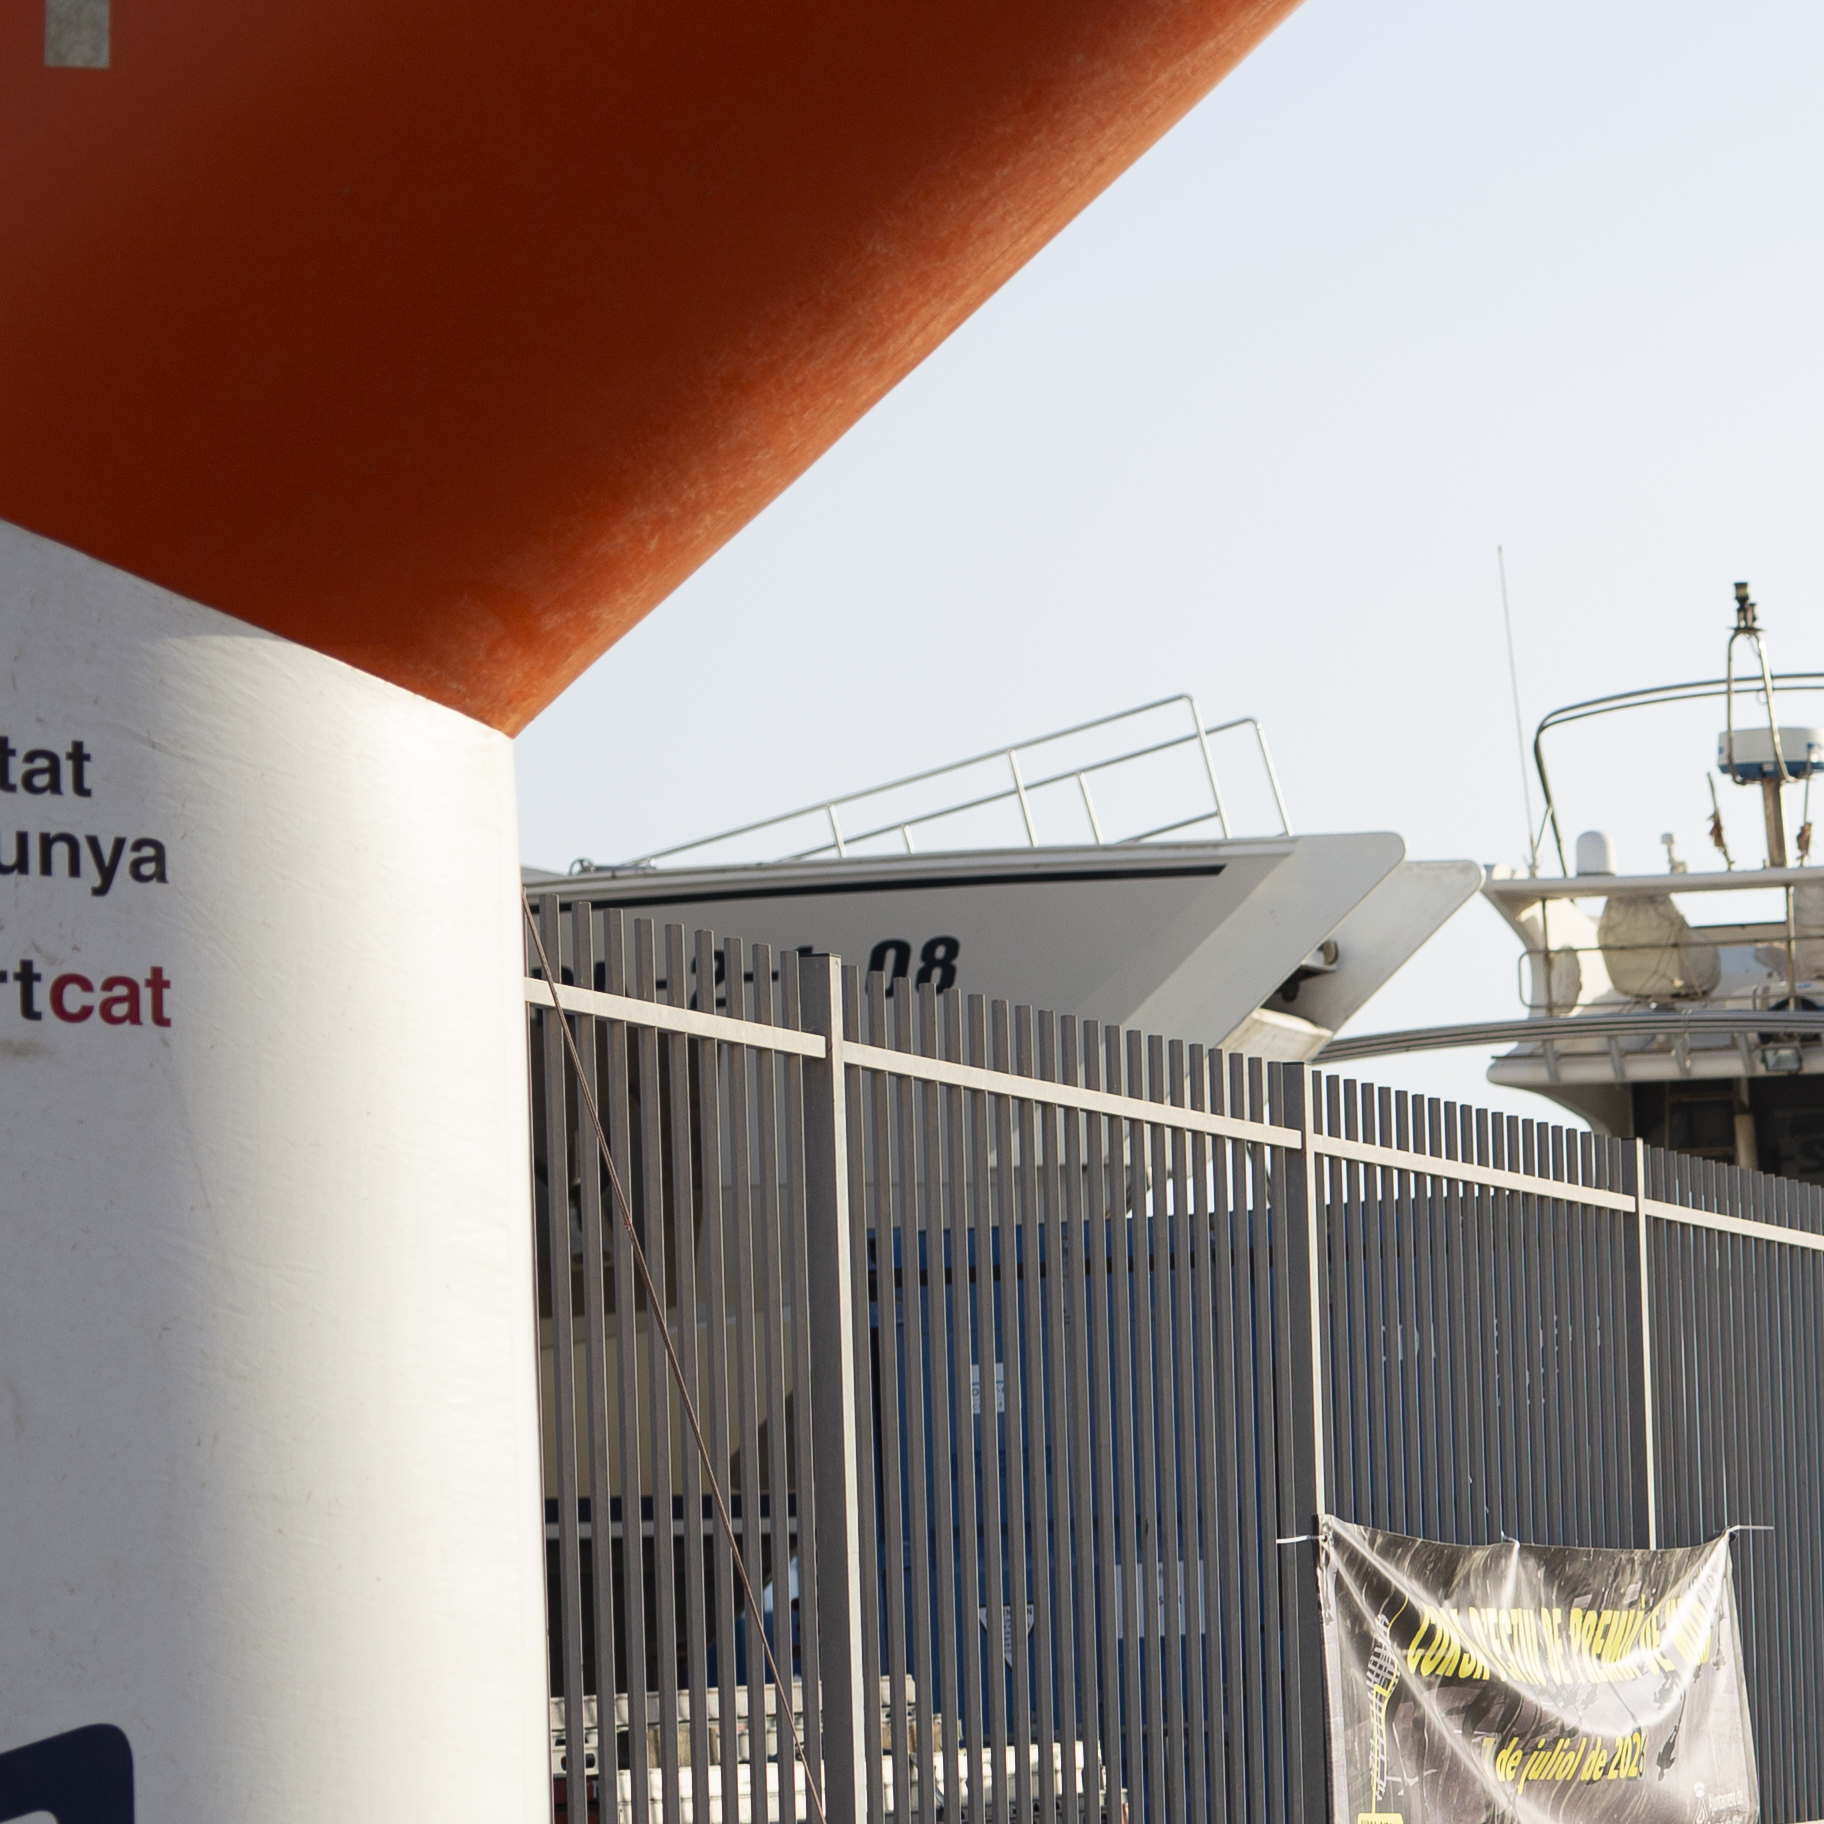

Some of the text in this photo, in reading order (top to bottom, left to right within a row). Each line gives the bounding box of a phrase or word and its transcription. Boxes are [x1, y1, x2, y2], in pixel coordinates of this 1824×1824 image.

[0, 958, 171, 1028] tcat
[1541, 1606, 1574, 1686] DE
[1496, 1736, 1523, 1783] de
[1517, 1737, 1588, 1796] juliol
[1580, 1735, 1608, 1781] de
